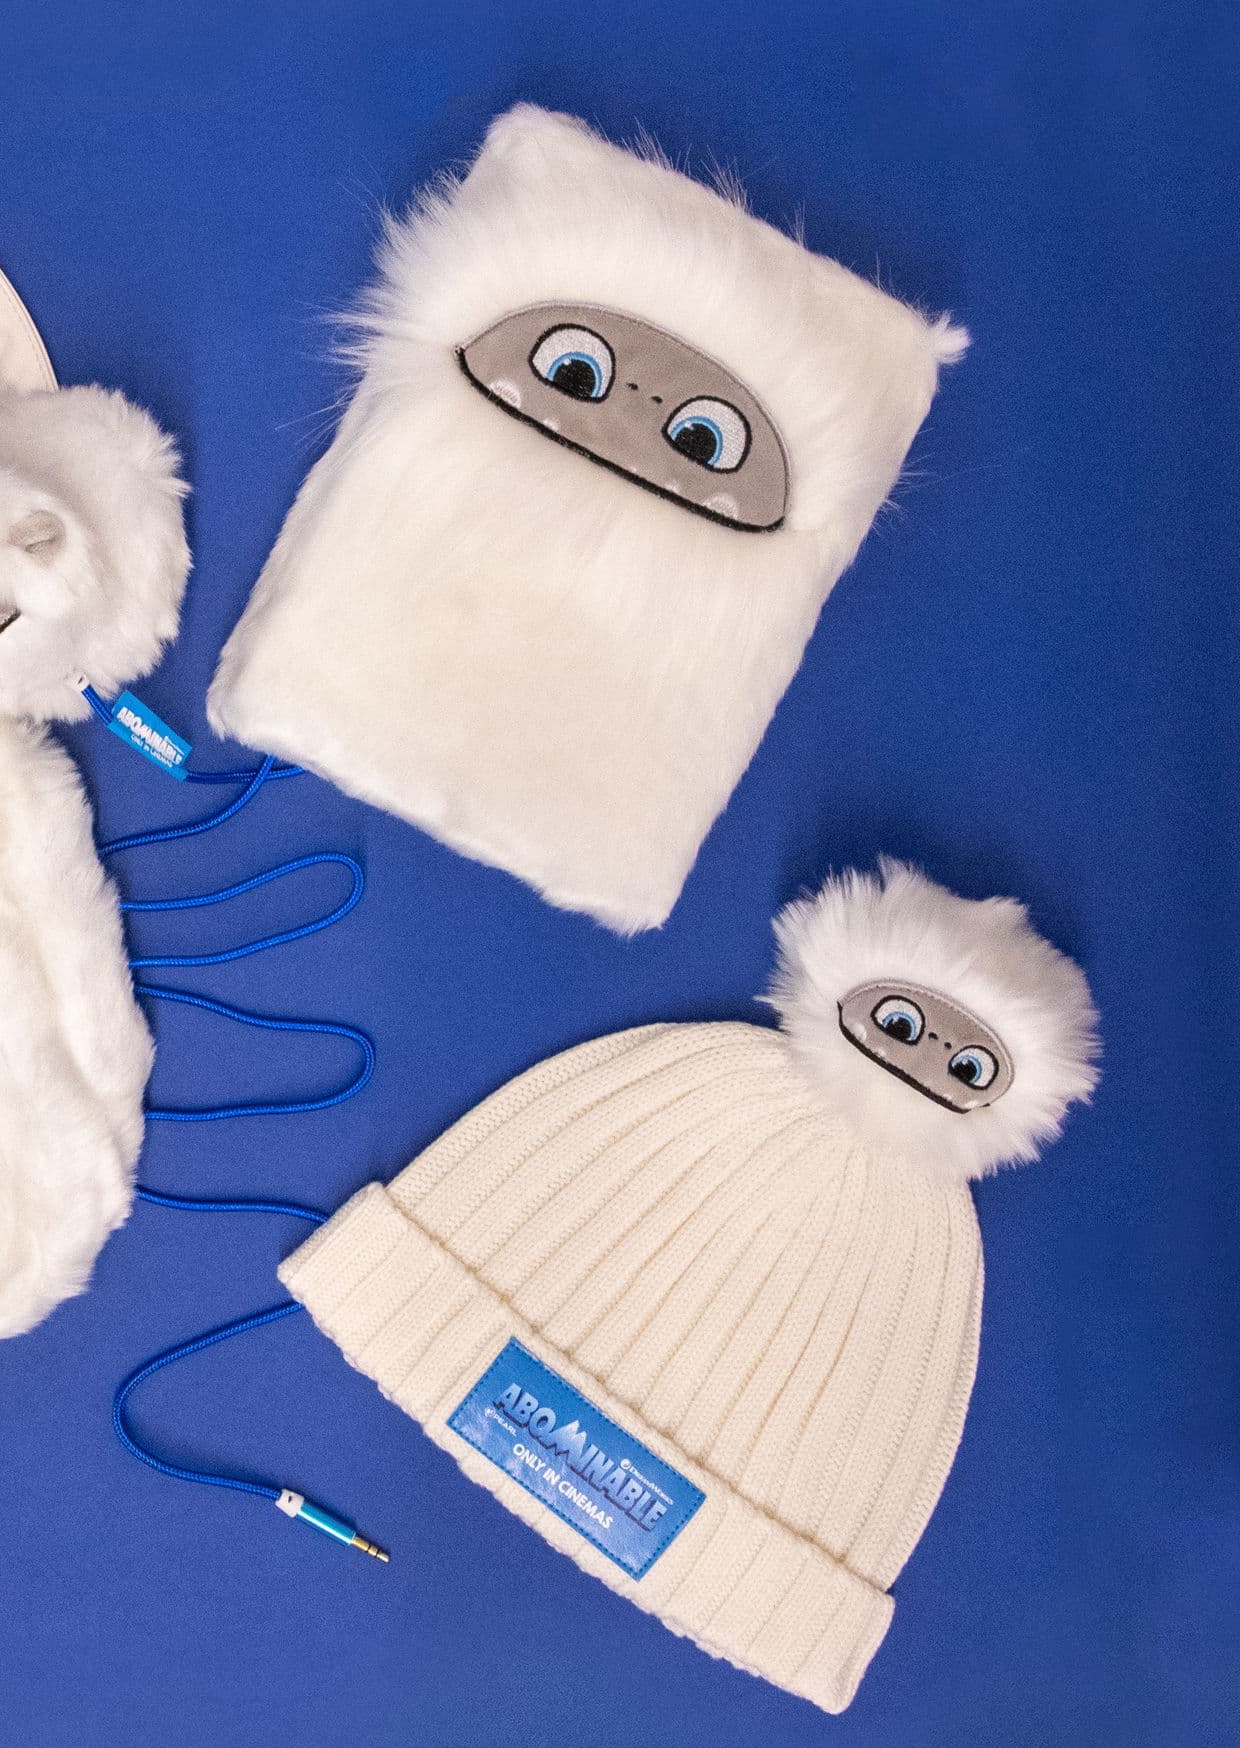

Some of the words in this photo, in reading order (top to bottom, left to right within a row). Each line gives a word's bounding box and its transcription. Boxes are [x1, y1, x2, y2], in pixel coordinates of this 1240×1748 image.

[492, 1413, 518, 1437] PEARL
[492, 1382, 668, 1532] ABOMINABLE
[513, 1443, 546, 1473] ONLY
[542, 1465, 560, 1485] IN
[557, 1480, 614, 1530] CINEMAS
